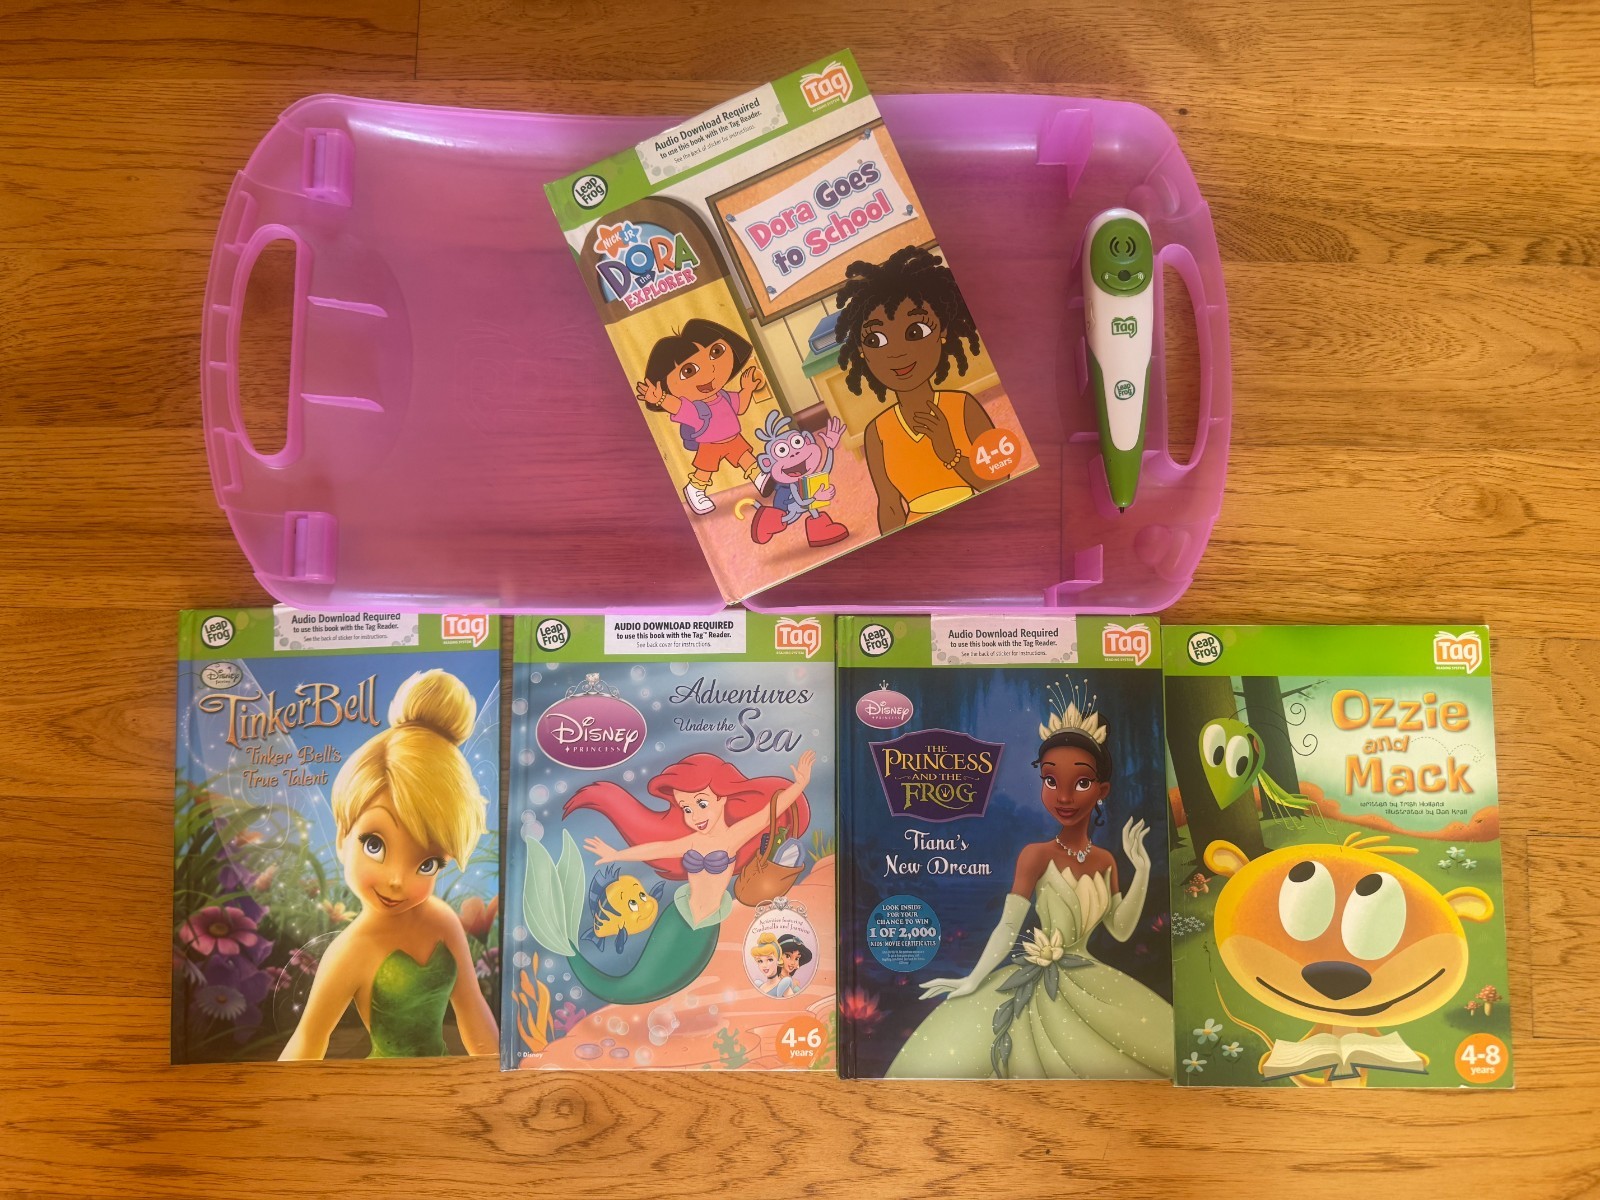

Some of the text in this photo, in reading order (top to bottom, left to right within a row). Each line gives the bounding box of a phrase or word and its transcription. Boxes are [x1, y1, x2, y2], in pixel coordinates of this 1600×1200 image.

[805, 72, 848, 101] Tag
[655, 98, 760, 151] Audio Download Required
[660, 110, 762, 159] to use this book with the Tag Reader.
[575, 177, 597, 198] Leap
[582, 185, 605, 204] Frog
[746, 162, 880, 250] Dora Goes
[602, 229, 635, 250] NICK JR
[773, 190, 893, 275] to School
[596, 232, 699, 300] DORA
[639, 272, 652, 285] the
[623, 268, 697, 310] EXPLORER
[1114, 322, 1135, 334] Tag
[975, 435, 1015, 465] 4-6
[989, 457, 1013, 474] years
[205, 620, 228, 634] Leap
[291, 612, 401, 624] Audio Download Required
[365, 623, 376, 631] Tag
[377, 622, 399, 630] Reader.
[446, 616, 484, 640] Tag
[614, 621, 734, 631] AUDIO DOWNLOAD REQUIRED
[207, 629, 231, 643] Frog
[540, 623, 563, 637] Leap
[542, 632, 566, 646] Frog
[779, 627, 817, 651] Tag
[863, 628, 886, 642] Leap
[948, 628, 1059, 639] Audio Download Required
[866, 637, 889, 651] Frog
[1023, 639, 1034, 648] Tag
[1106, 633, 1147, 658] Tag
[1191, 636, 1215, 650] Leap
[1194, 645, 1218, 659] Frog
[1437, 641, 1477, 666] Tag
[205, 668, 239, 682] Disney
[668, 676, 814, 704] Adventures
[1331, 689, 1470, 732] Ozzie
[673, 707, 802, 752] Under the Sea
[924, 745, 948, 753] THE
[1362, 734, 1411, 754] and
[245, 744, 342, 767] Tinker Bell's
[881, 748, 993, 778] PRINCESS
[242, 768, 329, 788] True Talent
[911, 773, 962, 781] AND THE
[1345, 754, 1474, 796] Mack
[901, 782, 978, 810] FROG
[1425, 808, 1435, 816] by
[904, 829, 970, 851] Tiana's
[883, 854, 993, 877] New Dream
[869, 926, 937, 940] 1 OF 2,000
[781, 1027, 822, 1048] 4-6
[523, 1051, 544, 1059] Disney
[789, 1049, 814, 1059] years
[1460, 1044, 1501, 1066] 4-8
[1470, 1066, 1496, 1076] years
